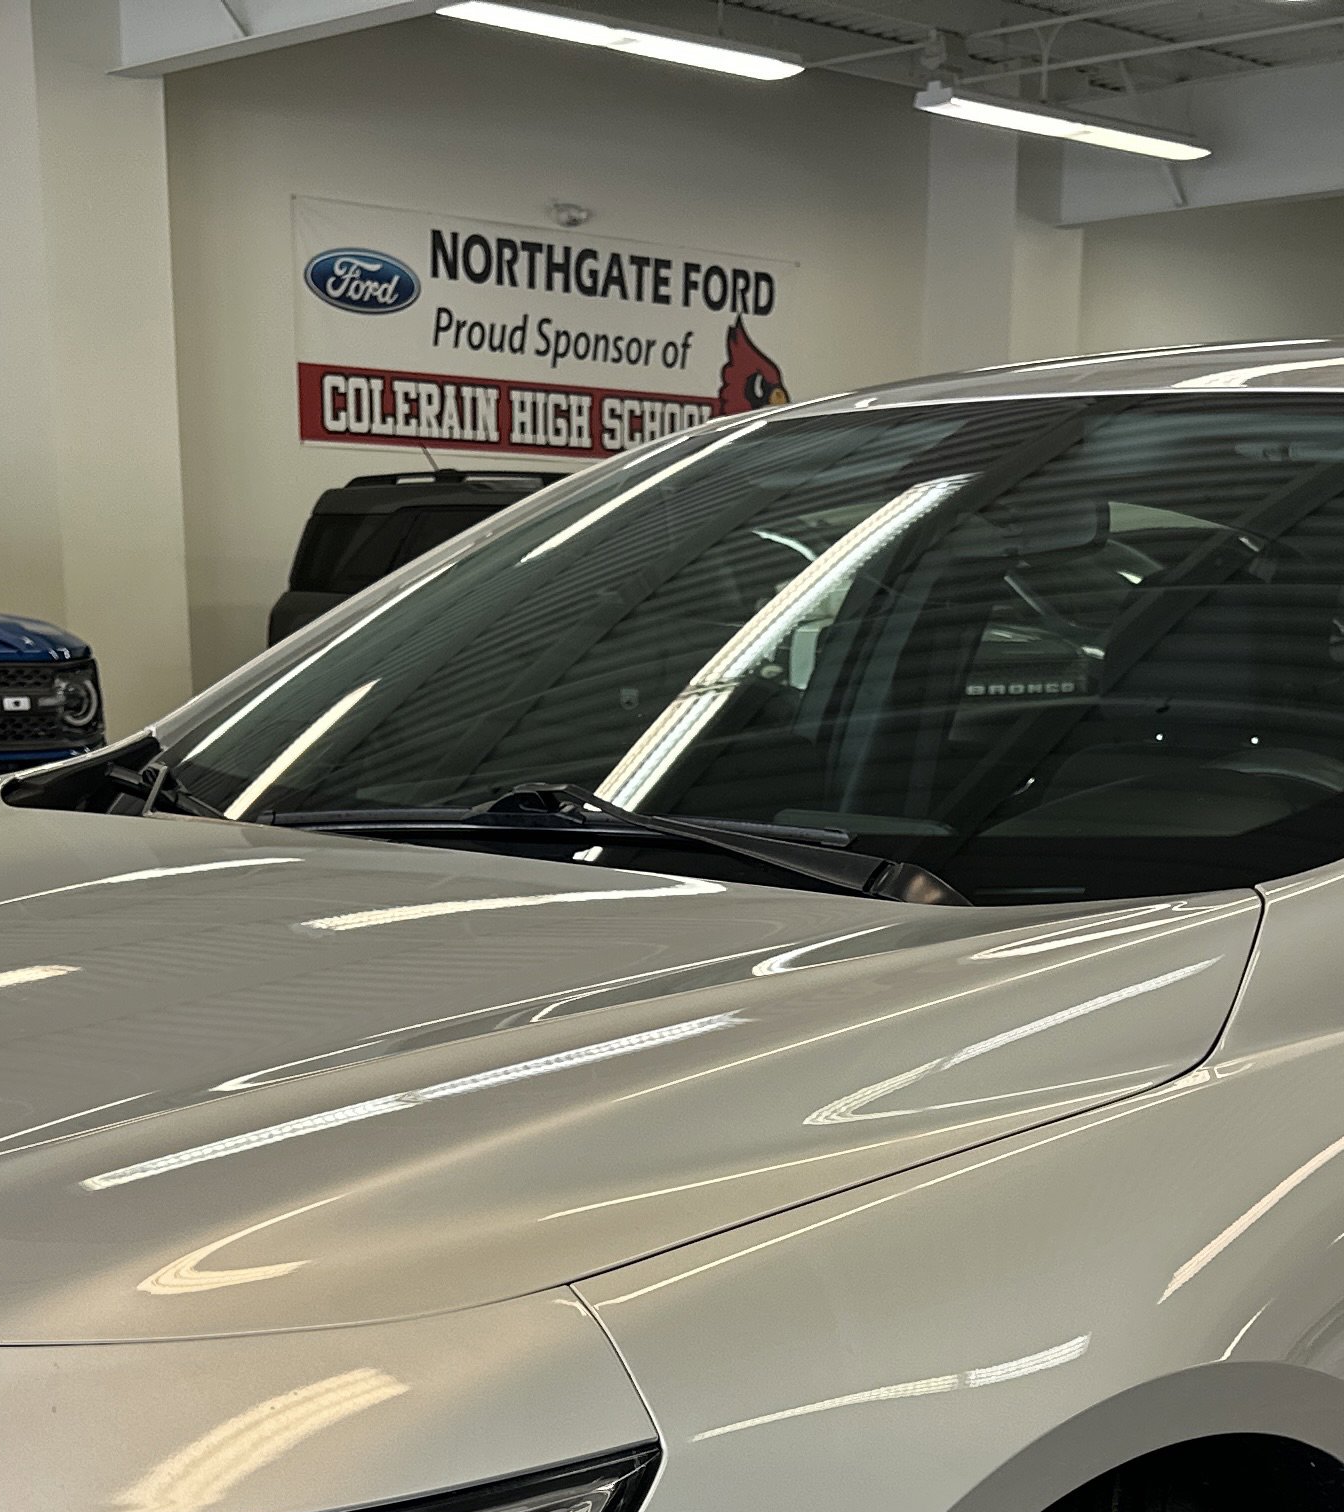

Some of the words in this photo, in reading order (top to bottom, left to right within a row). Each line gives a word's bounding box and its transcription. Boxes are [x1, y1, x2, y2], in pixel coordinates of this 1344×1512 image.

[327, 257, 399, 305] Ford
[430, 229, 672, 305] NORTHGATE
[684, 262, 775, 316] FORD
[432, 307, 529, 356] Proud
[535, 317, 656, 368] Sponsor
[661, 331, 695, 369] of
[321, 374, 500, 444] COLERAIN
[511, 389, 592, 449] HIGH
[967, 683, 1074, 696] BRONCO
